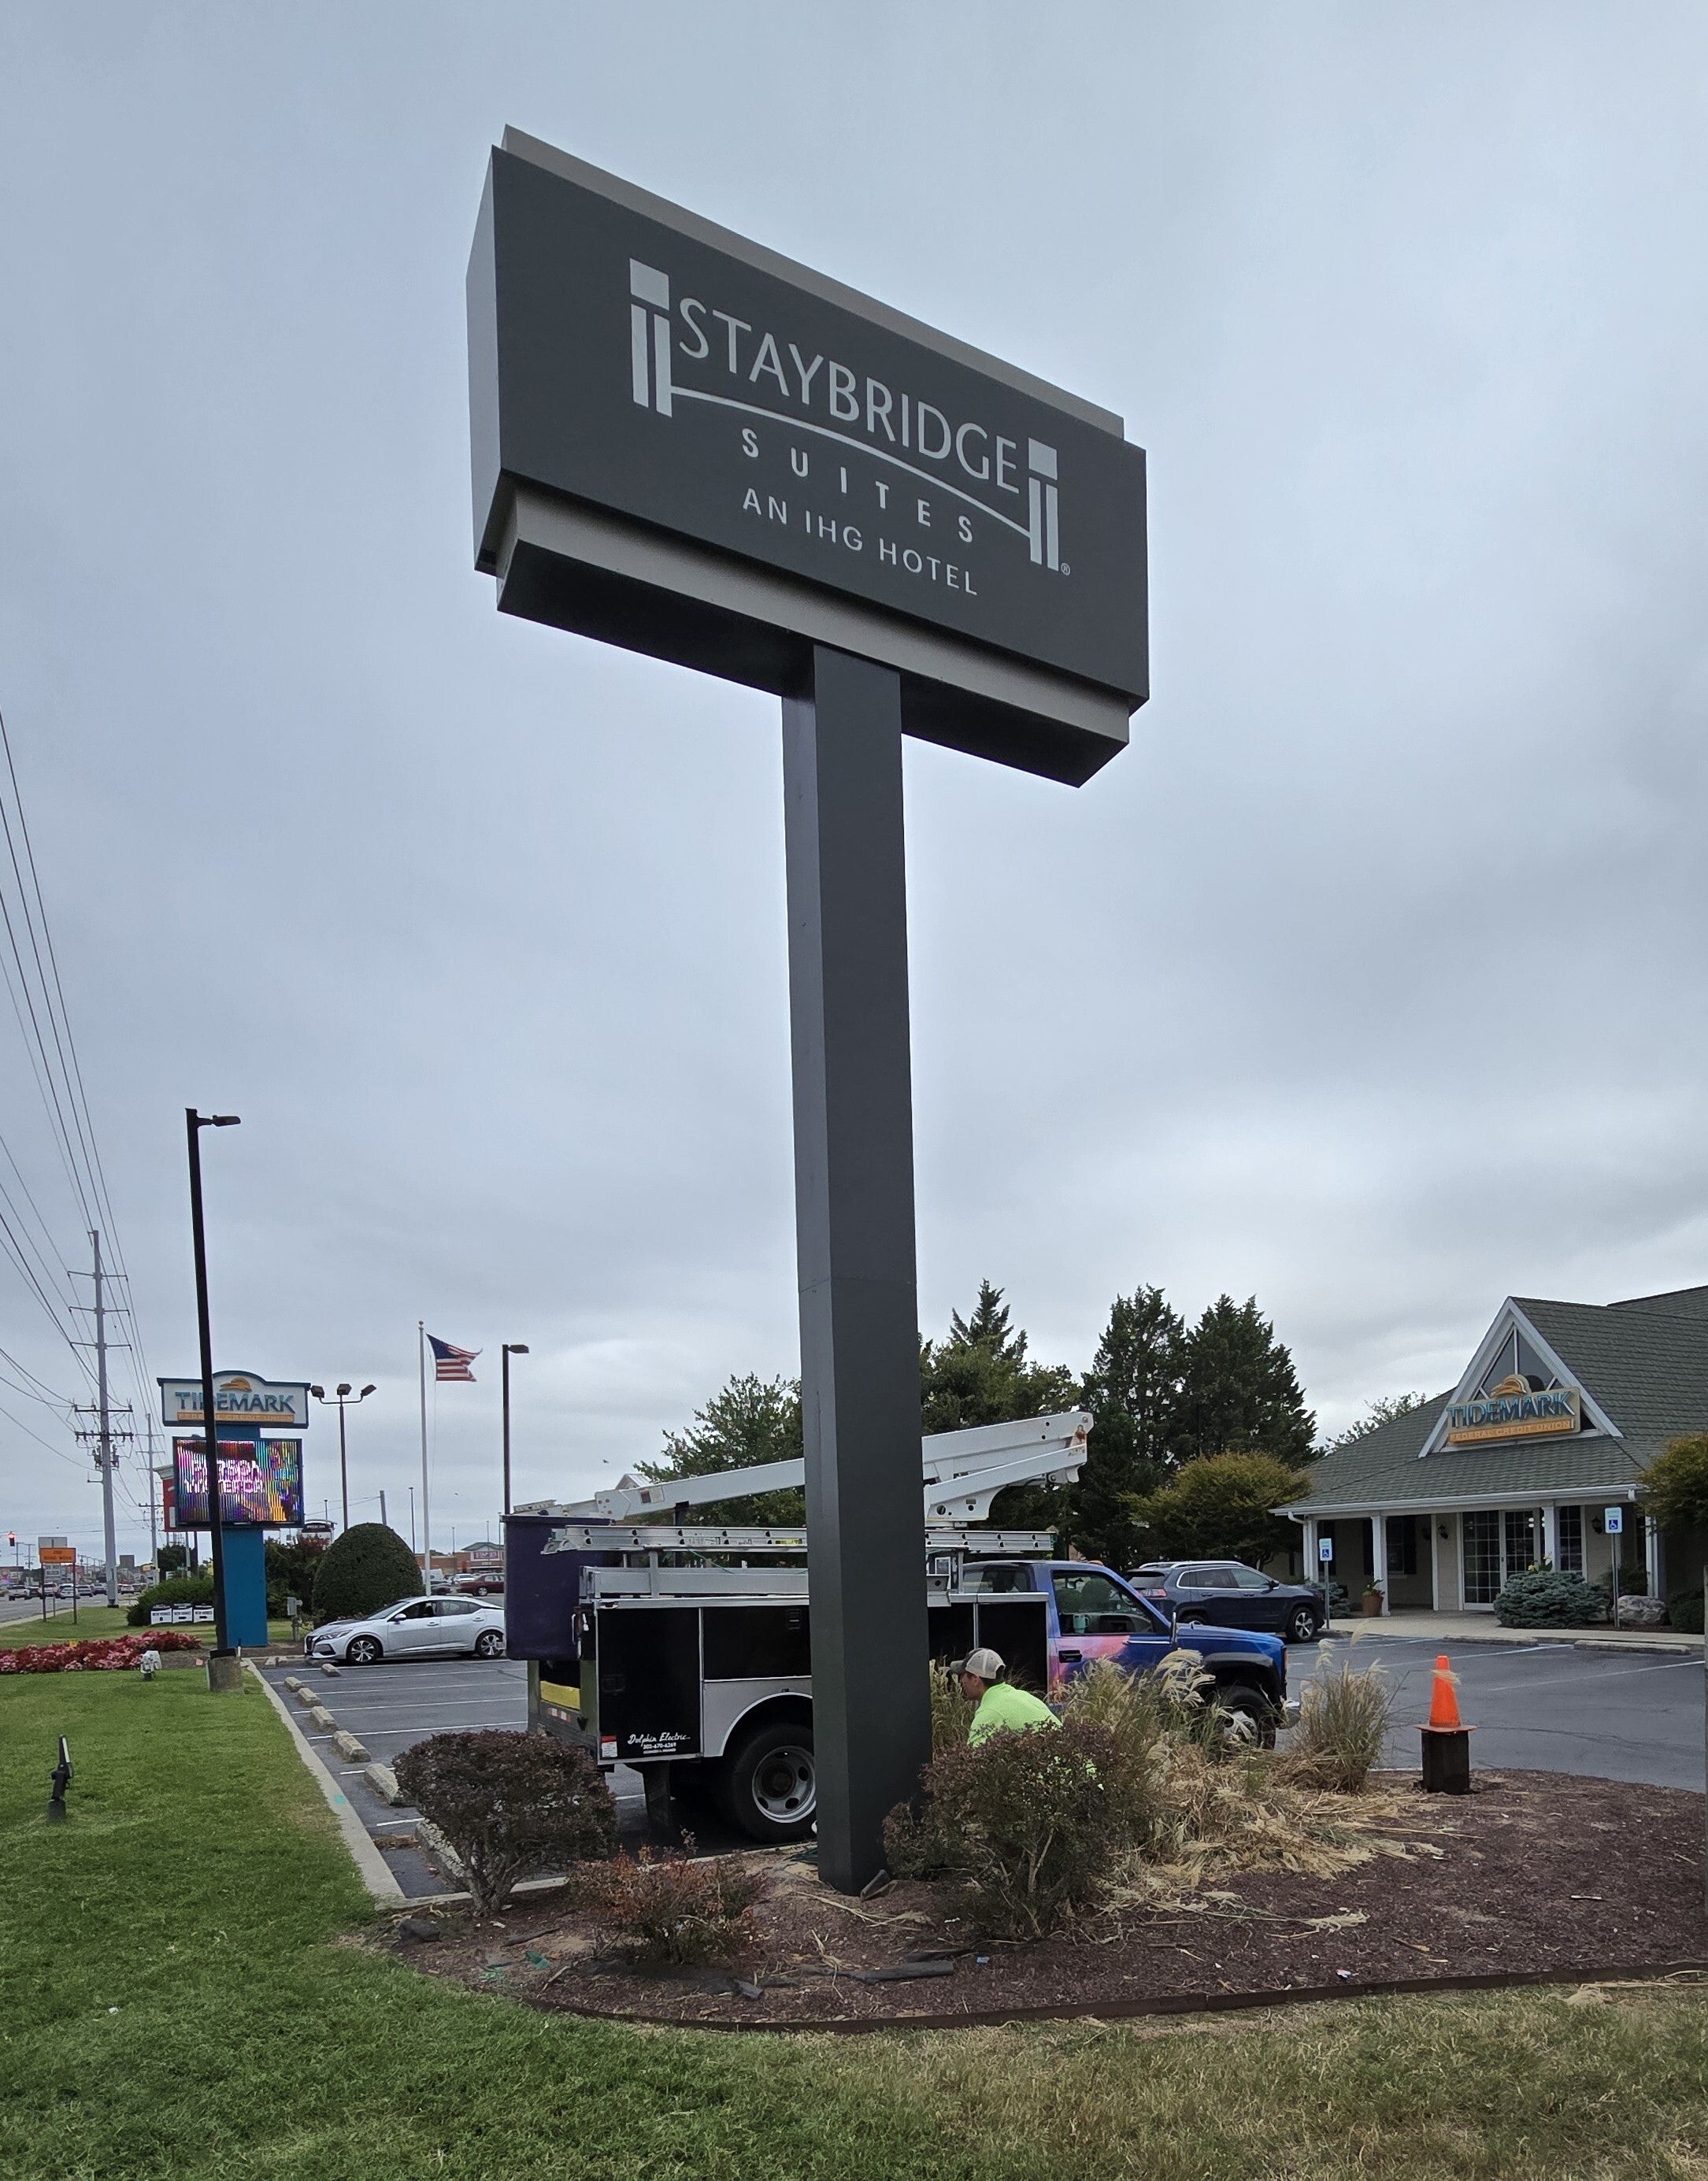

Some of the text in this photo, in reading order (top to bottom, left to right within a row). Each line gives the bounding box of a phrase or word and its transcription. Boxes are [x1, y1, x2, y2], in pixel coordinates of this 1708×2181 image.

[679, 298, 1020, 494] STAYBRIDGE
[742, 428, 973, 543] SUITES
[743, 487, 978, 596] AN IHG HOTEL
[1446, 1390, 1575, 1427] TIDEMARK
[1450, 1420, 1571, 1441] FEDERAL CREDIT UNION
[628, 1732, 691, 1746] Dolphin Electric
